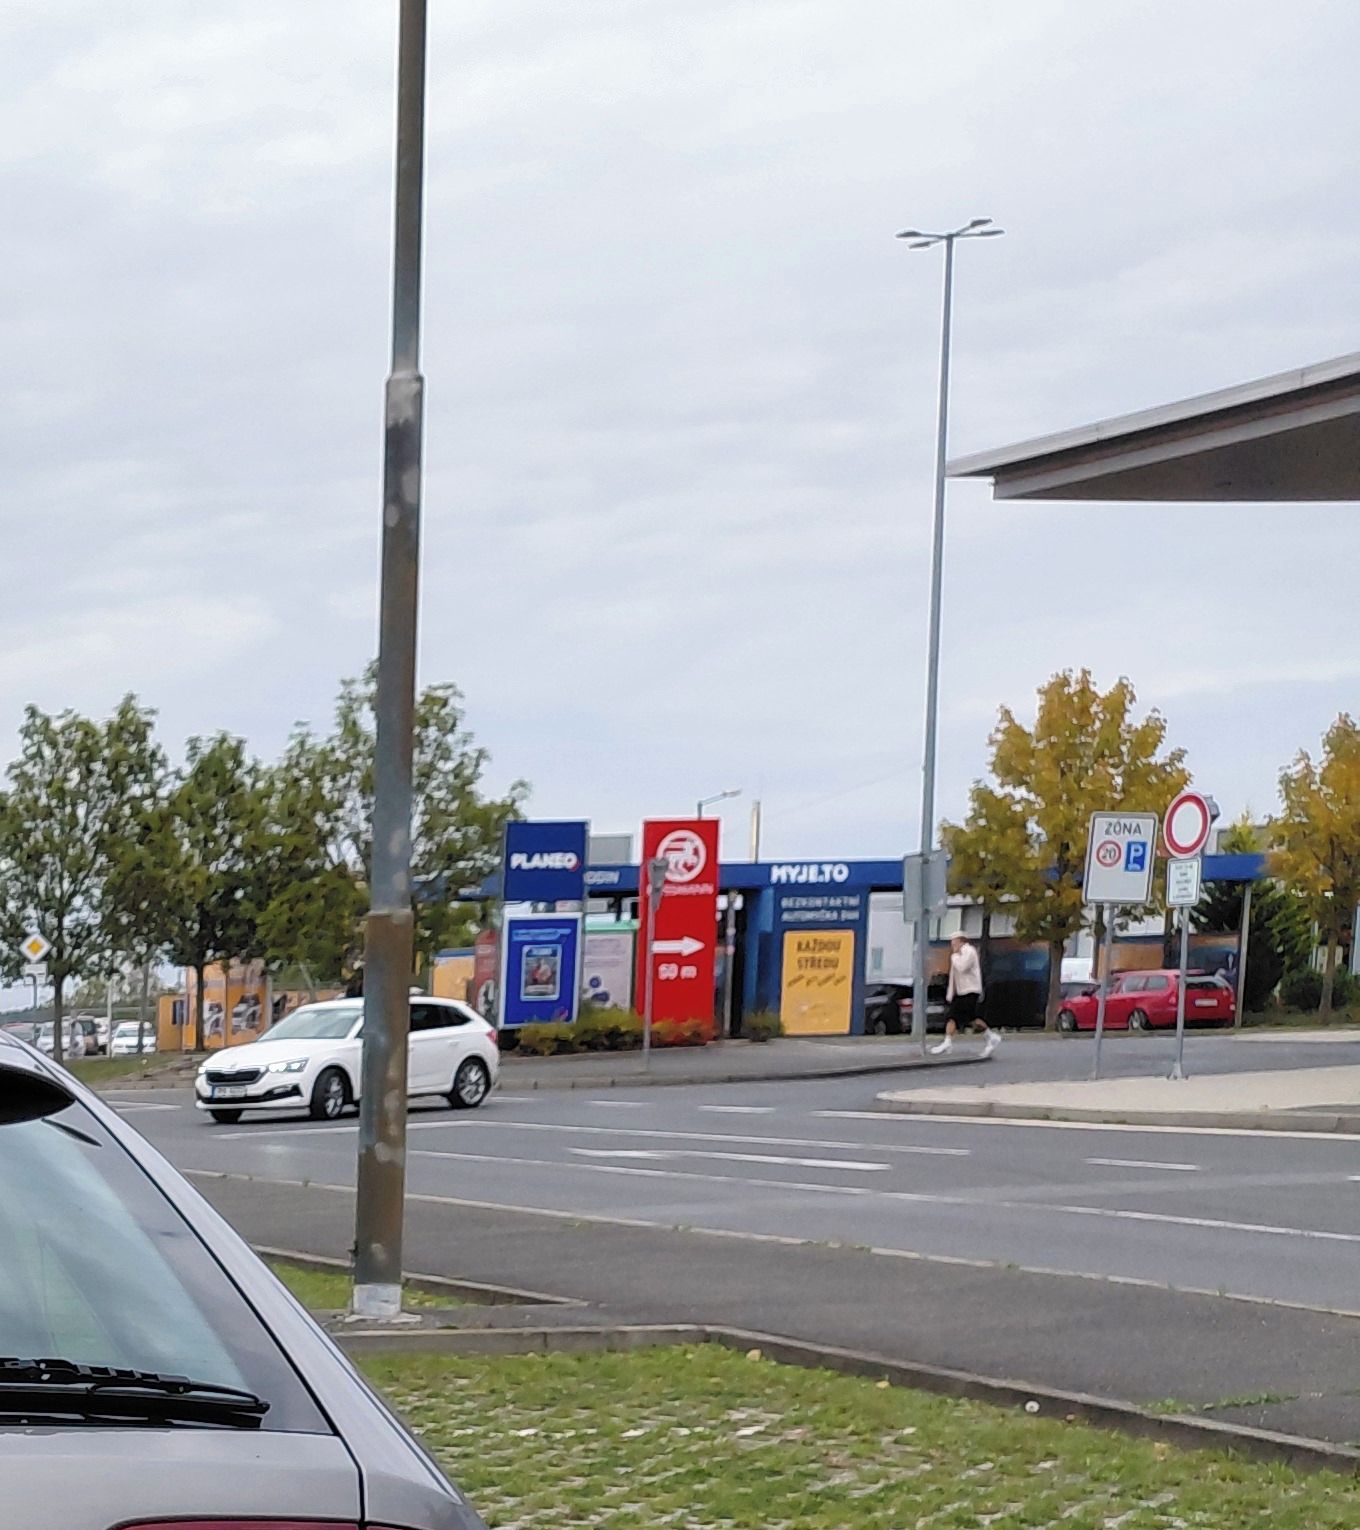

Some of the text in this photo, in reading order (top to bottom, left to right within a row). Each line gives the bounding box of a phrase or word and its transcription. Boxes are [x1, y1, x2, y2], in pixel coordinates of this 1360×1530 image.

[1104, 818, 1142, 836] ZÓNA
[509, 852, 580, 870] PLANEO
[1101, 847, 1117, 860] 20
[770, 863, 850, 884] MYJE.TO
